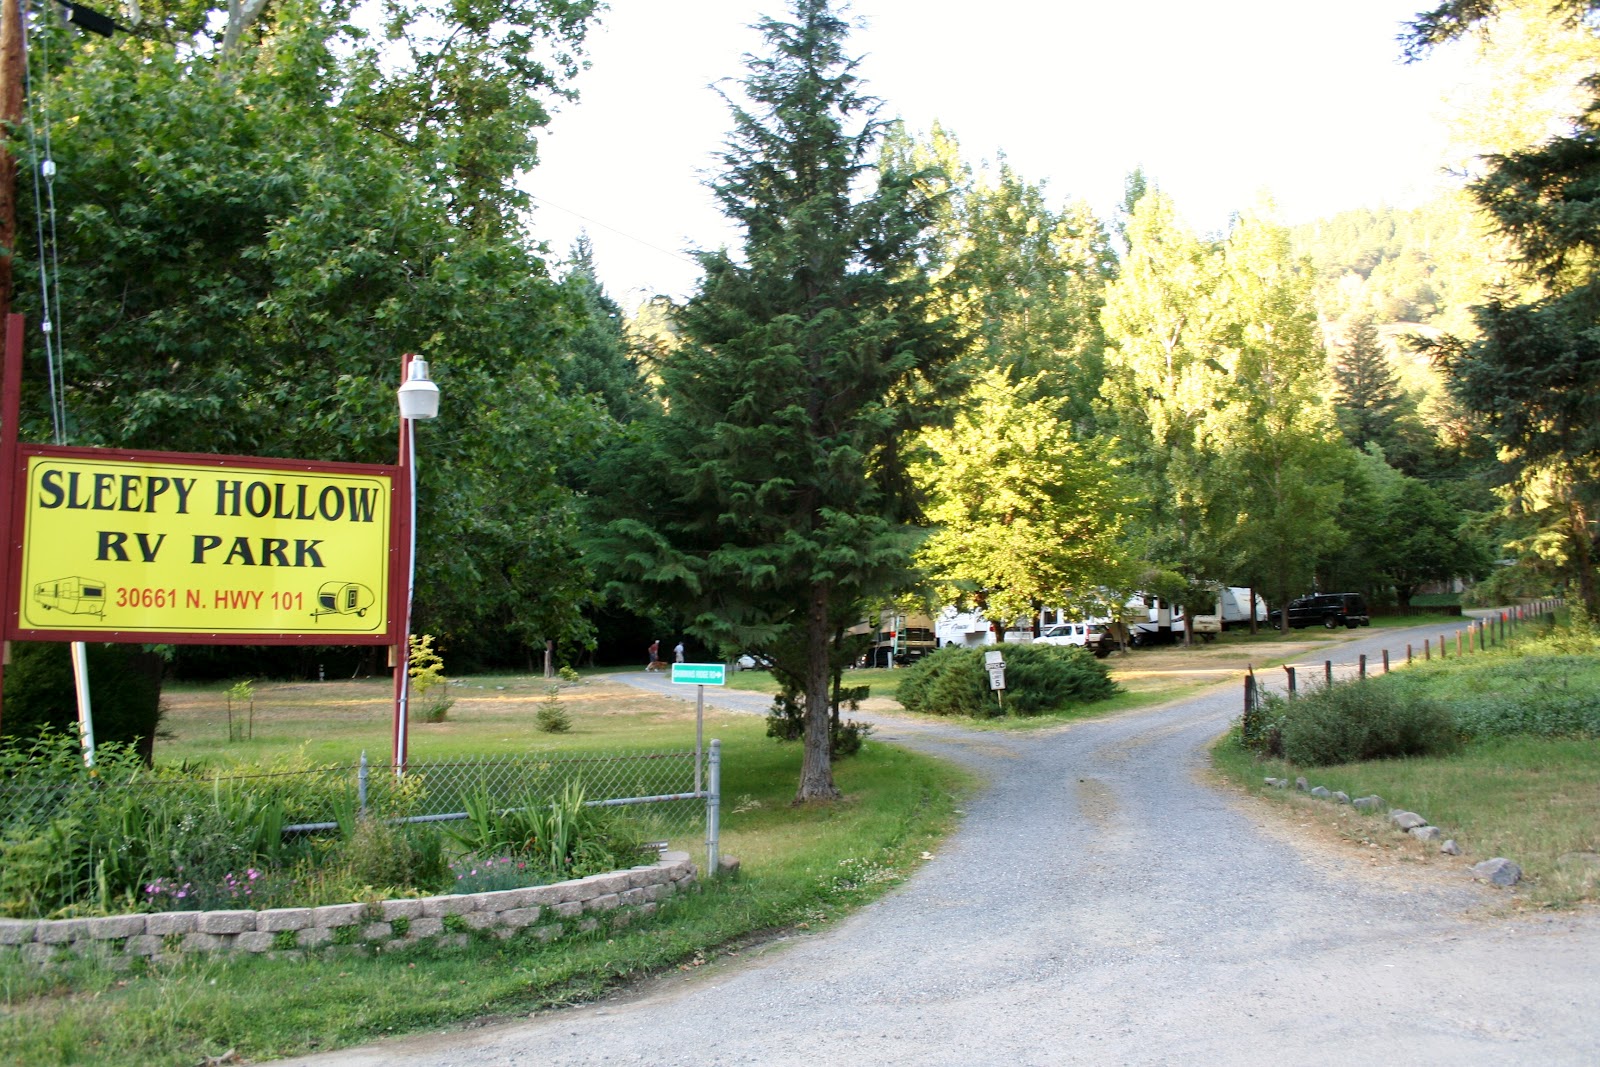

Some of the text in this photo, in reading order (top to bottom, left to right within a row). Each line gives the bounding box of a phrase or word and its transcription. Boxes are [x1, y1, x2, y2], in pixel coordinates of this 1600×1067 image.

[39, 469, 379, 523] SLEEPY HOLLOW
[95, 531, 326, 568] RV PARK
[116, 588, 303, 611] 30661 N. HWY 101
